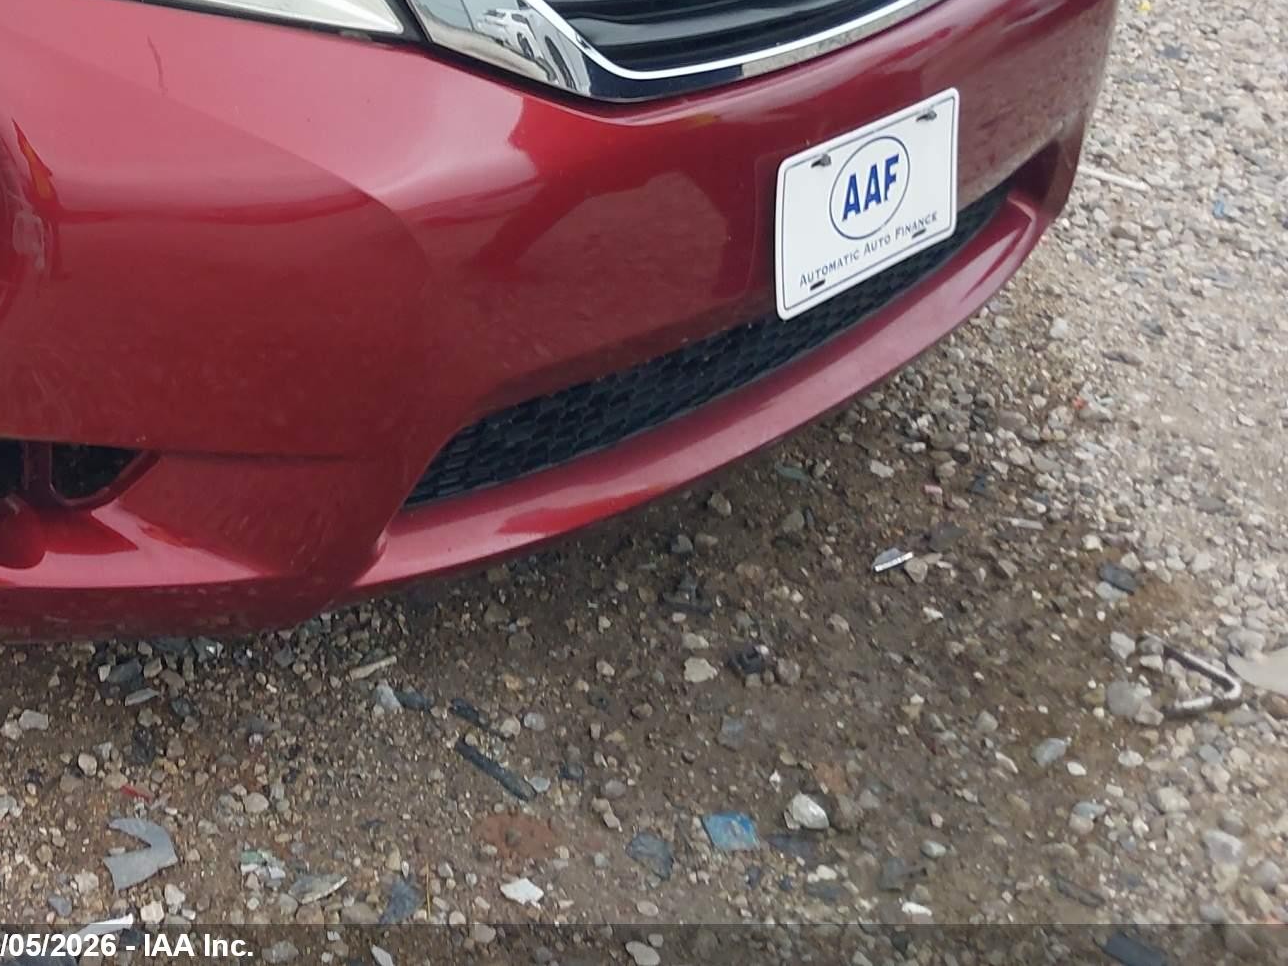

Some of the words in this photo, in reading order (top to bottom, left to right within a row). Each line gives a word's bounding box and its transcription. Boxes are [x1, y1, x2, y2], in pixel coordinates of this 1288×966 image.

[842, 153, 899, 222] AAF
[799, 249, 860, 288] AUTOMATIC
[863, 234, 891, 256] AUTO
[895, 210, 938, 240] FINANCE
